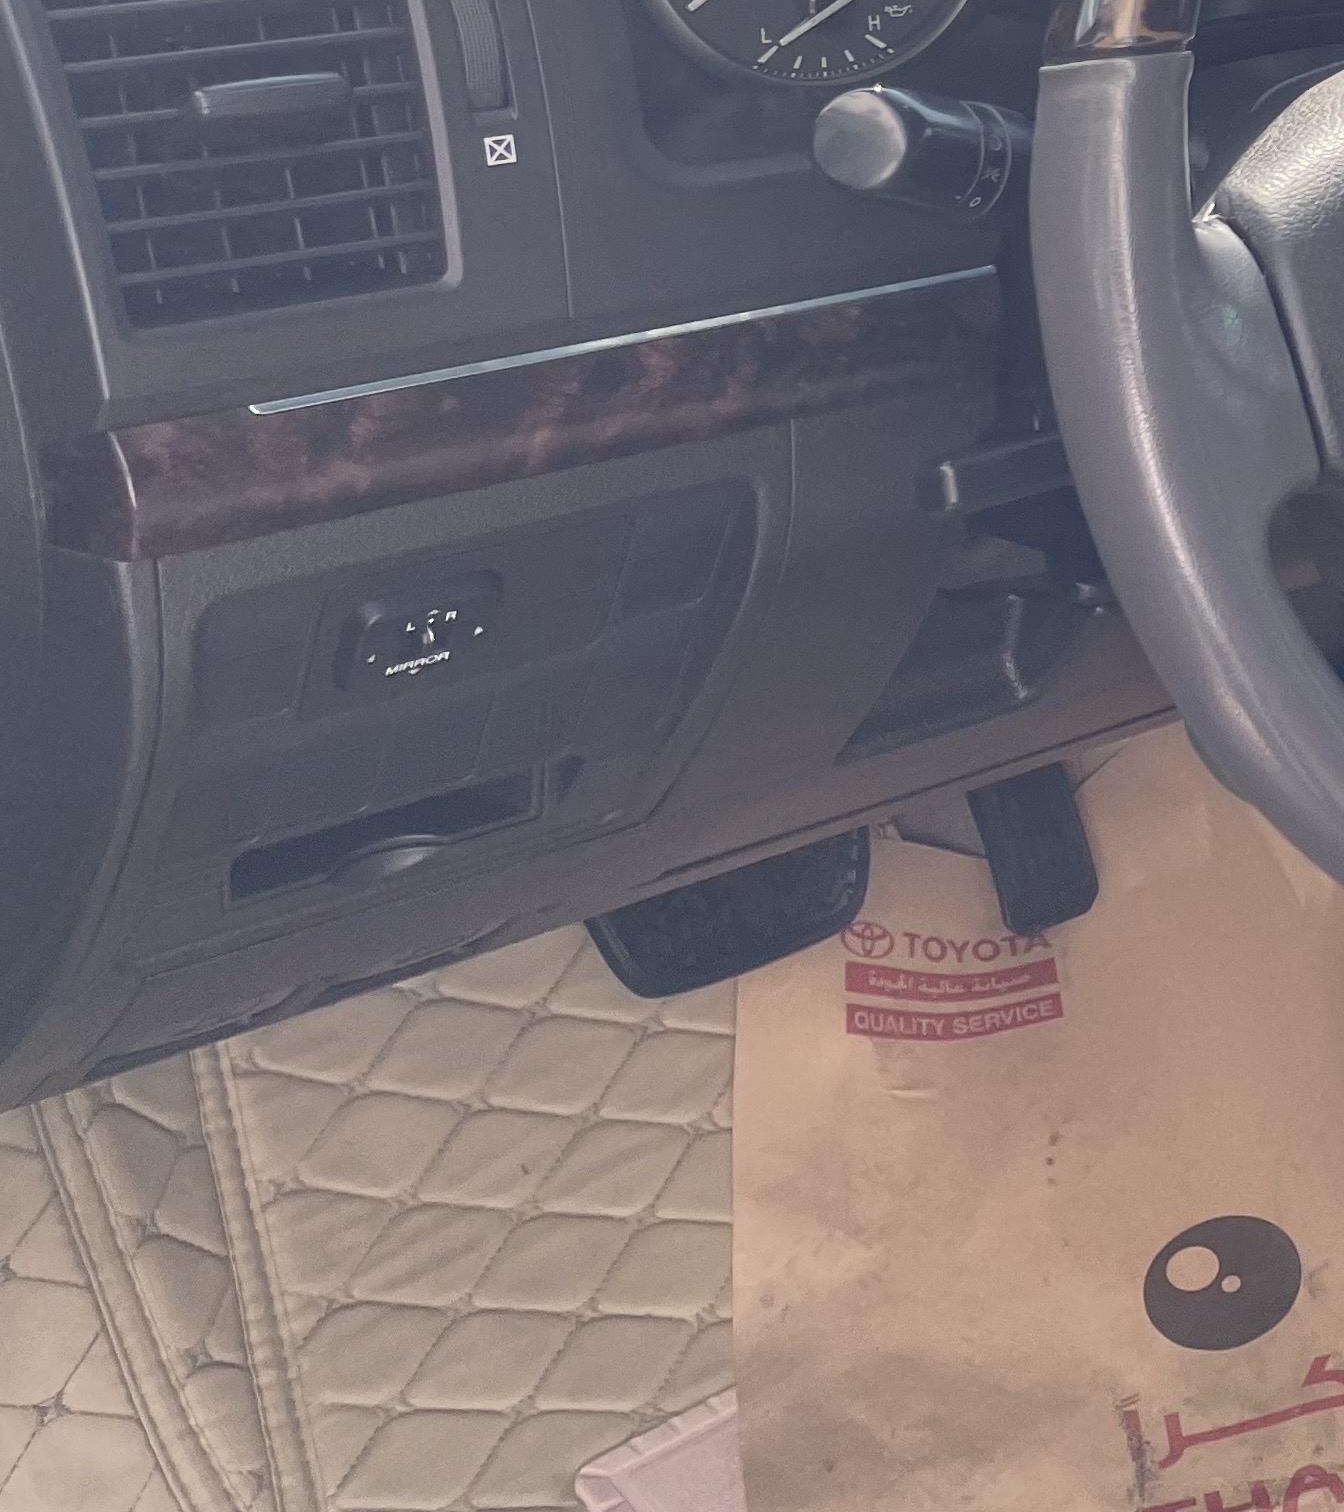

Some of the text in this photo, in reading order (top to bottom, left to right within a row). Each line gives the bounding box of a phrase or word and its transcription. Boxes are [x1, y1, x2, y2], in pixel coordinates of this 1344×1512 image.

[760, 27, 772, 44] L
[868, 15, 881, 31] H
[385, 651, 450, 676] MIRROR
[902, 931, 1052, 963] TOYOTA
[854, 999, 1054, 1036] QUALITY SERVICE
